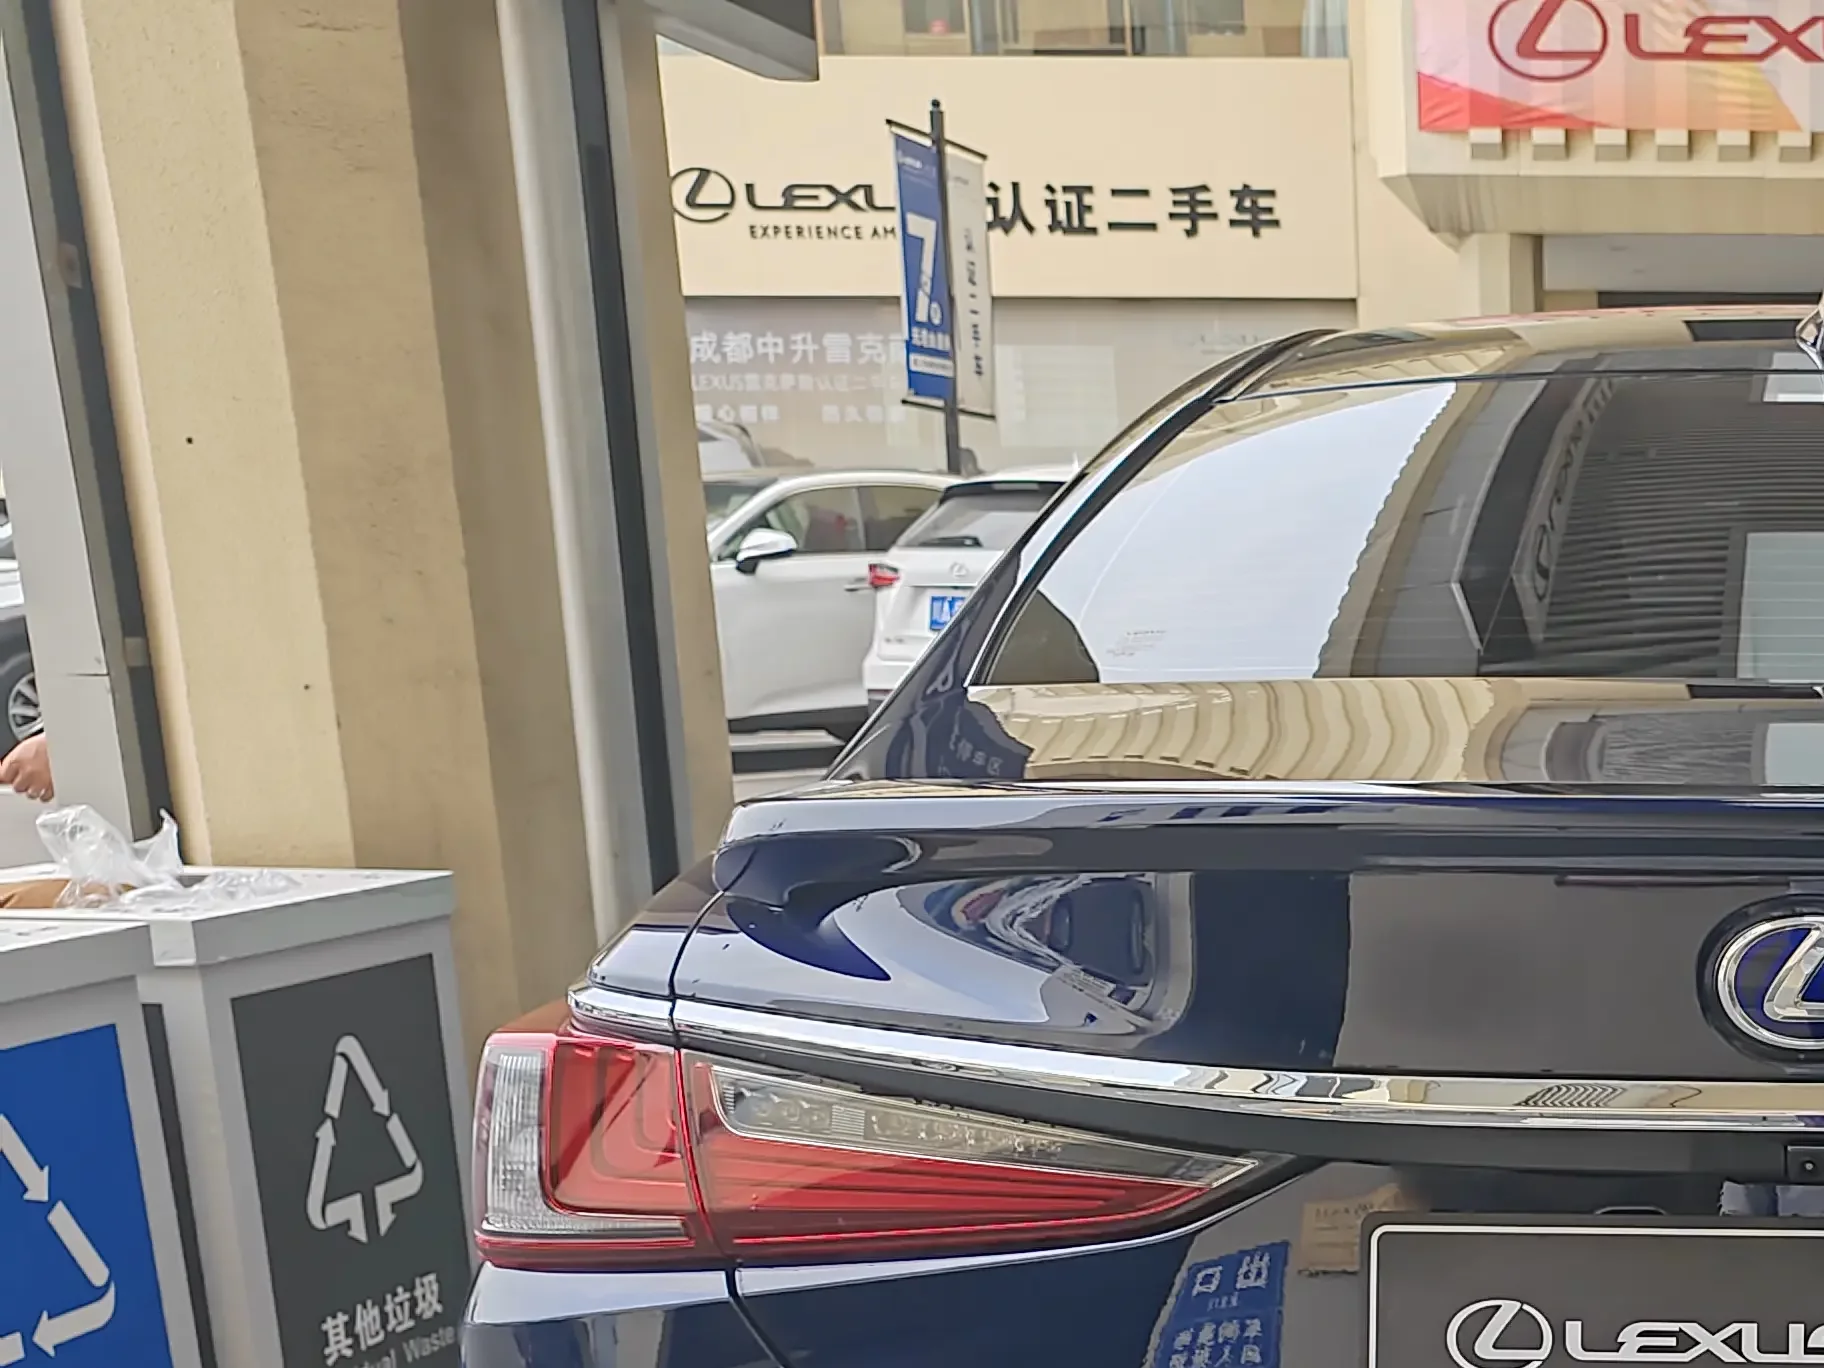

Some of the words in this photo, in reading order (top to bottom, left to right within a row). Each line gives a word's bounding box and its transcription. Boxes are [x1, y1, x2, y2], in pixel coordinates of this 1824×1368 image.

[745, 183, 896, 212] LEXU
[986, 181, 1281, 239] 认证二手车
[749, 225, 864, 240] EXPERIENCE
[321, 1272, 443, 1366] 其他垃圾
[401, 1325, 456, 1363] Waste
